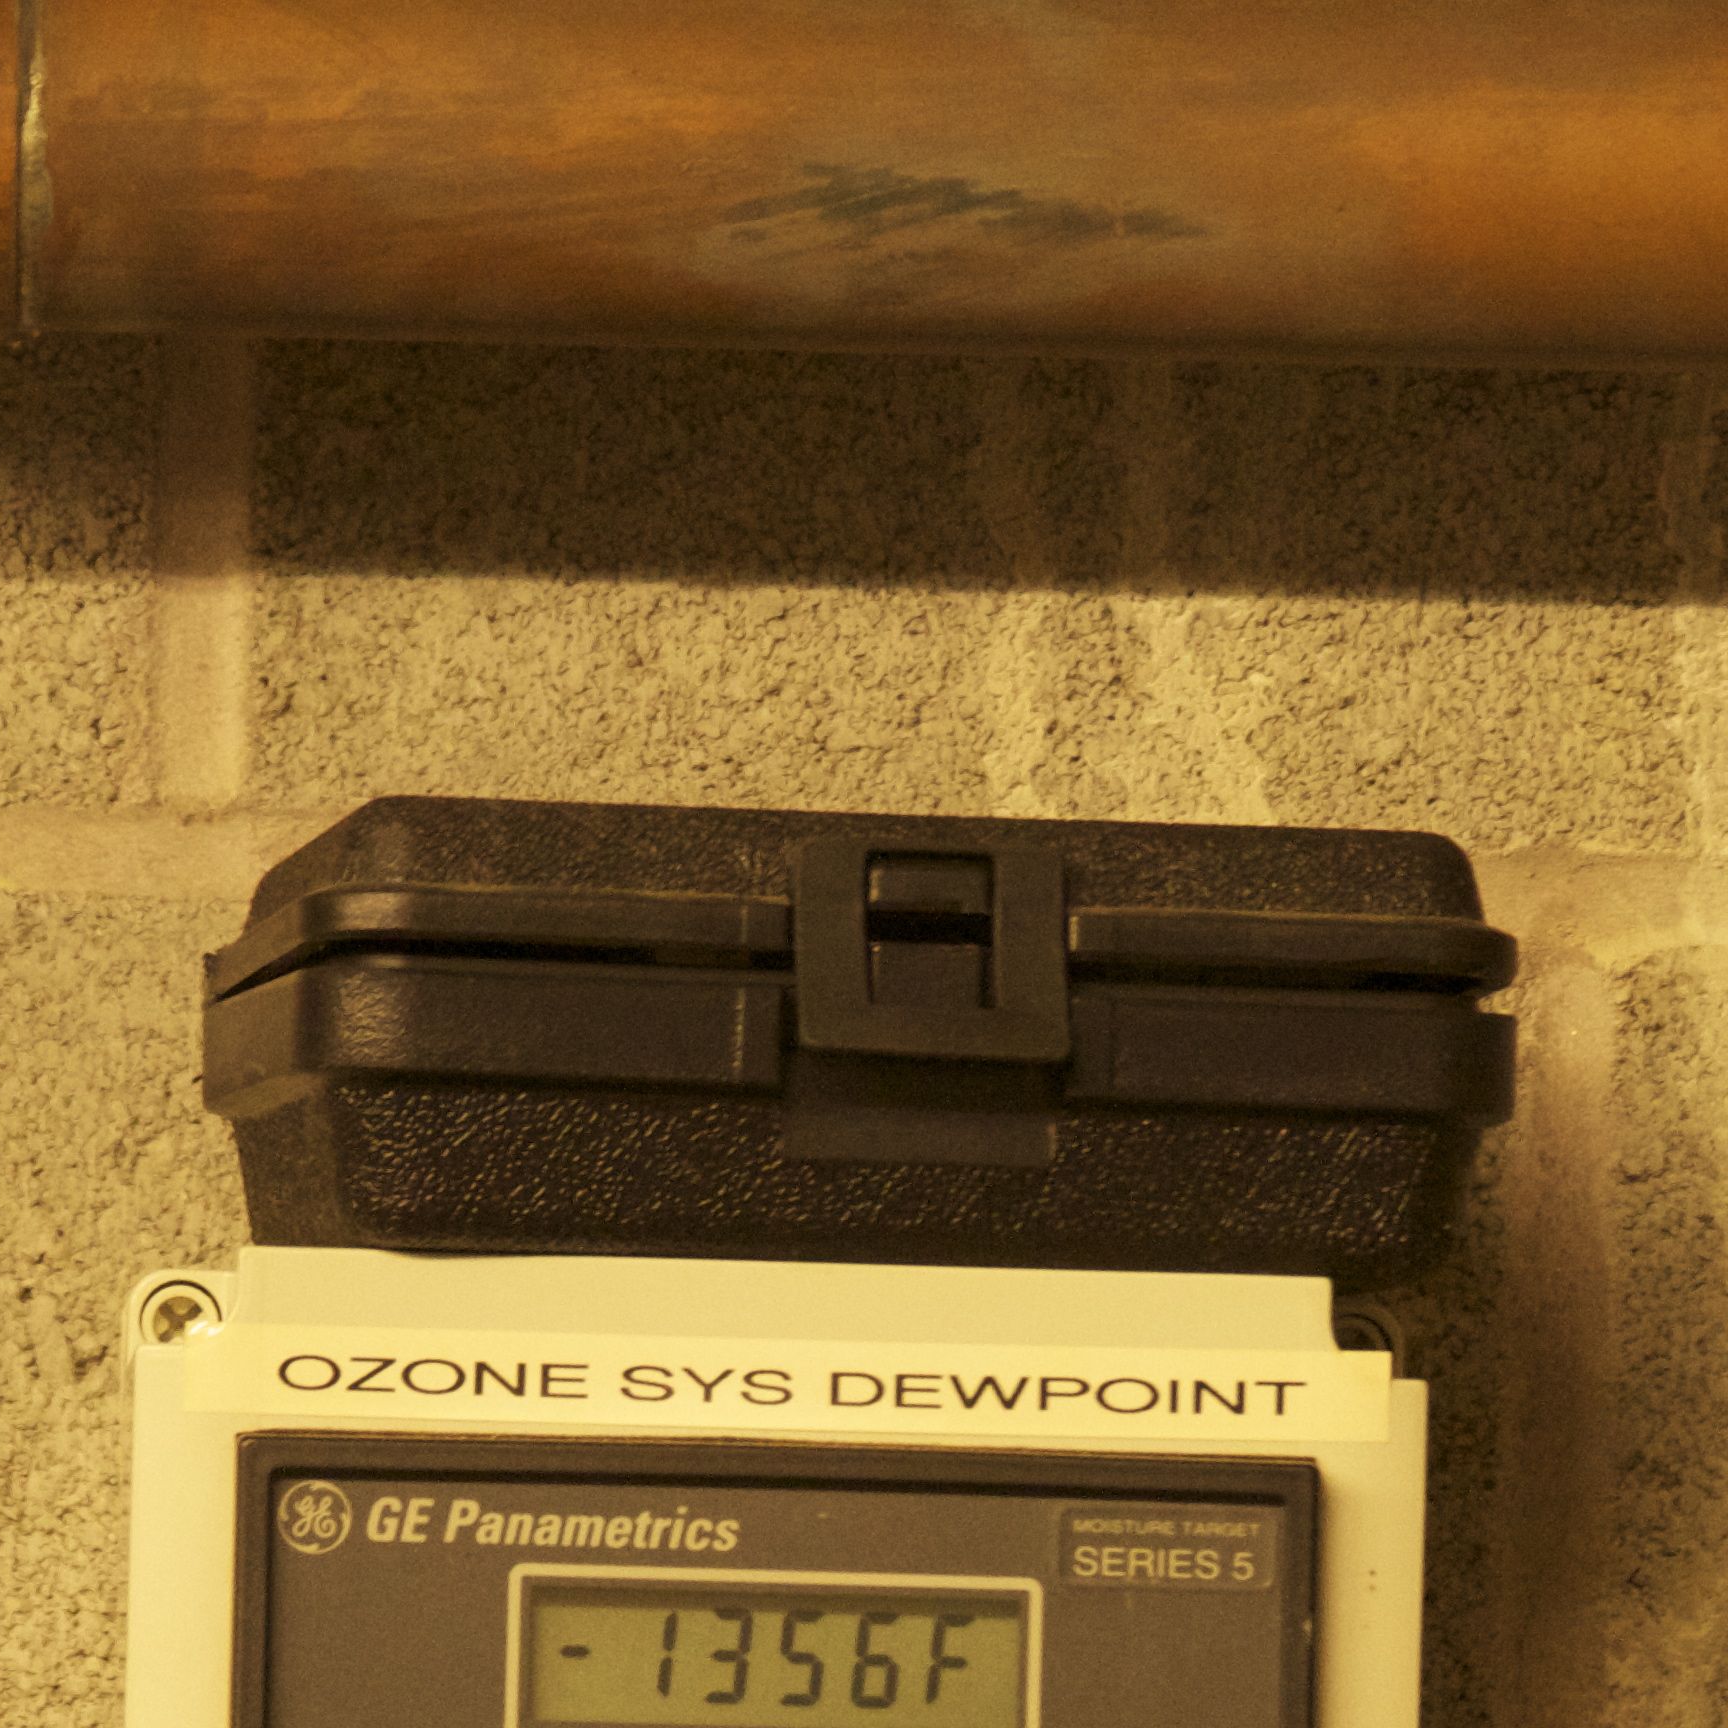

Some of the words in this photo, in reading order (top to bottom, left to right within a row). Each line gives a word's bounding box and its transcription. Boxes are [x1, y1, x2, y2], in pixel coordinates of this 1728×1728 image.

[278, 1354, 589, 1399] OZONE
[620, 1365, 794, 1406] SYS
[829, 1371, 1307, 1416] DEWPOINT
[366, 1496, 435, 1543] GE
[443, 1499, 741, 1552] Panametrics
[1073, 1545, 1221, 1580] SERIES
[1231, 1550, 1256, 1581] 5
